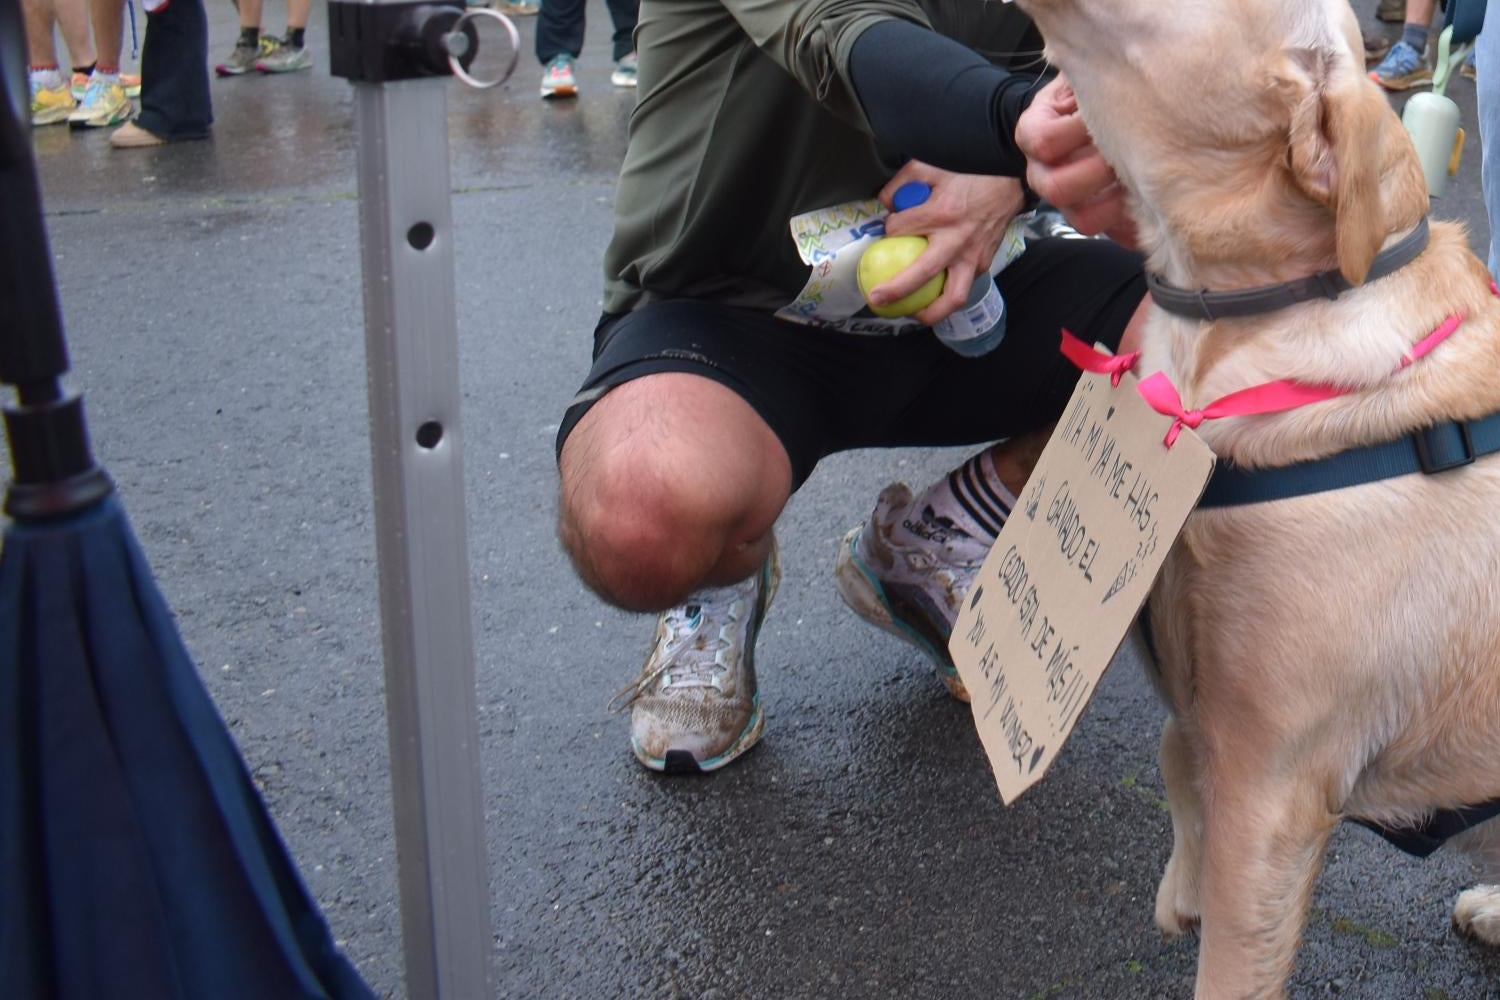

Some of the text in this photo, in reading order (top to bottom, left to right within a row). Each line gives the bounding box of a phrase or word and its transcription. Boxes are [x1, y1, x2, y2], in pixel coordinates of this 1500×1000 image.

[1081, 421, 1104, 462] MI
[1091, 433, 1116, 479] YA
[1105, 452, 1133, 499] ME
[1123, 472, 1159, 532] HAS
[1078, 538, 1100, 584] EL
[1030, 616, 1055, 660] DE
[966, 609, 986, 648] YOU
[983, 666, 1009, 721] MY
